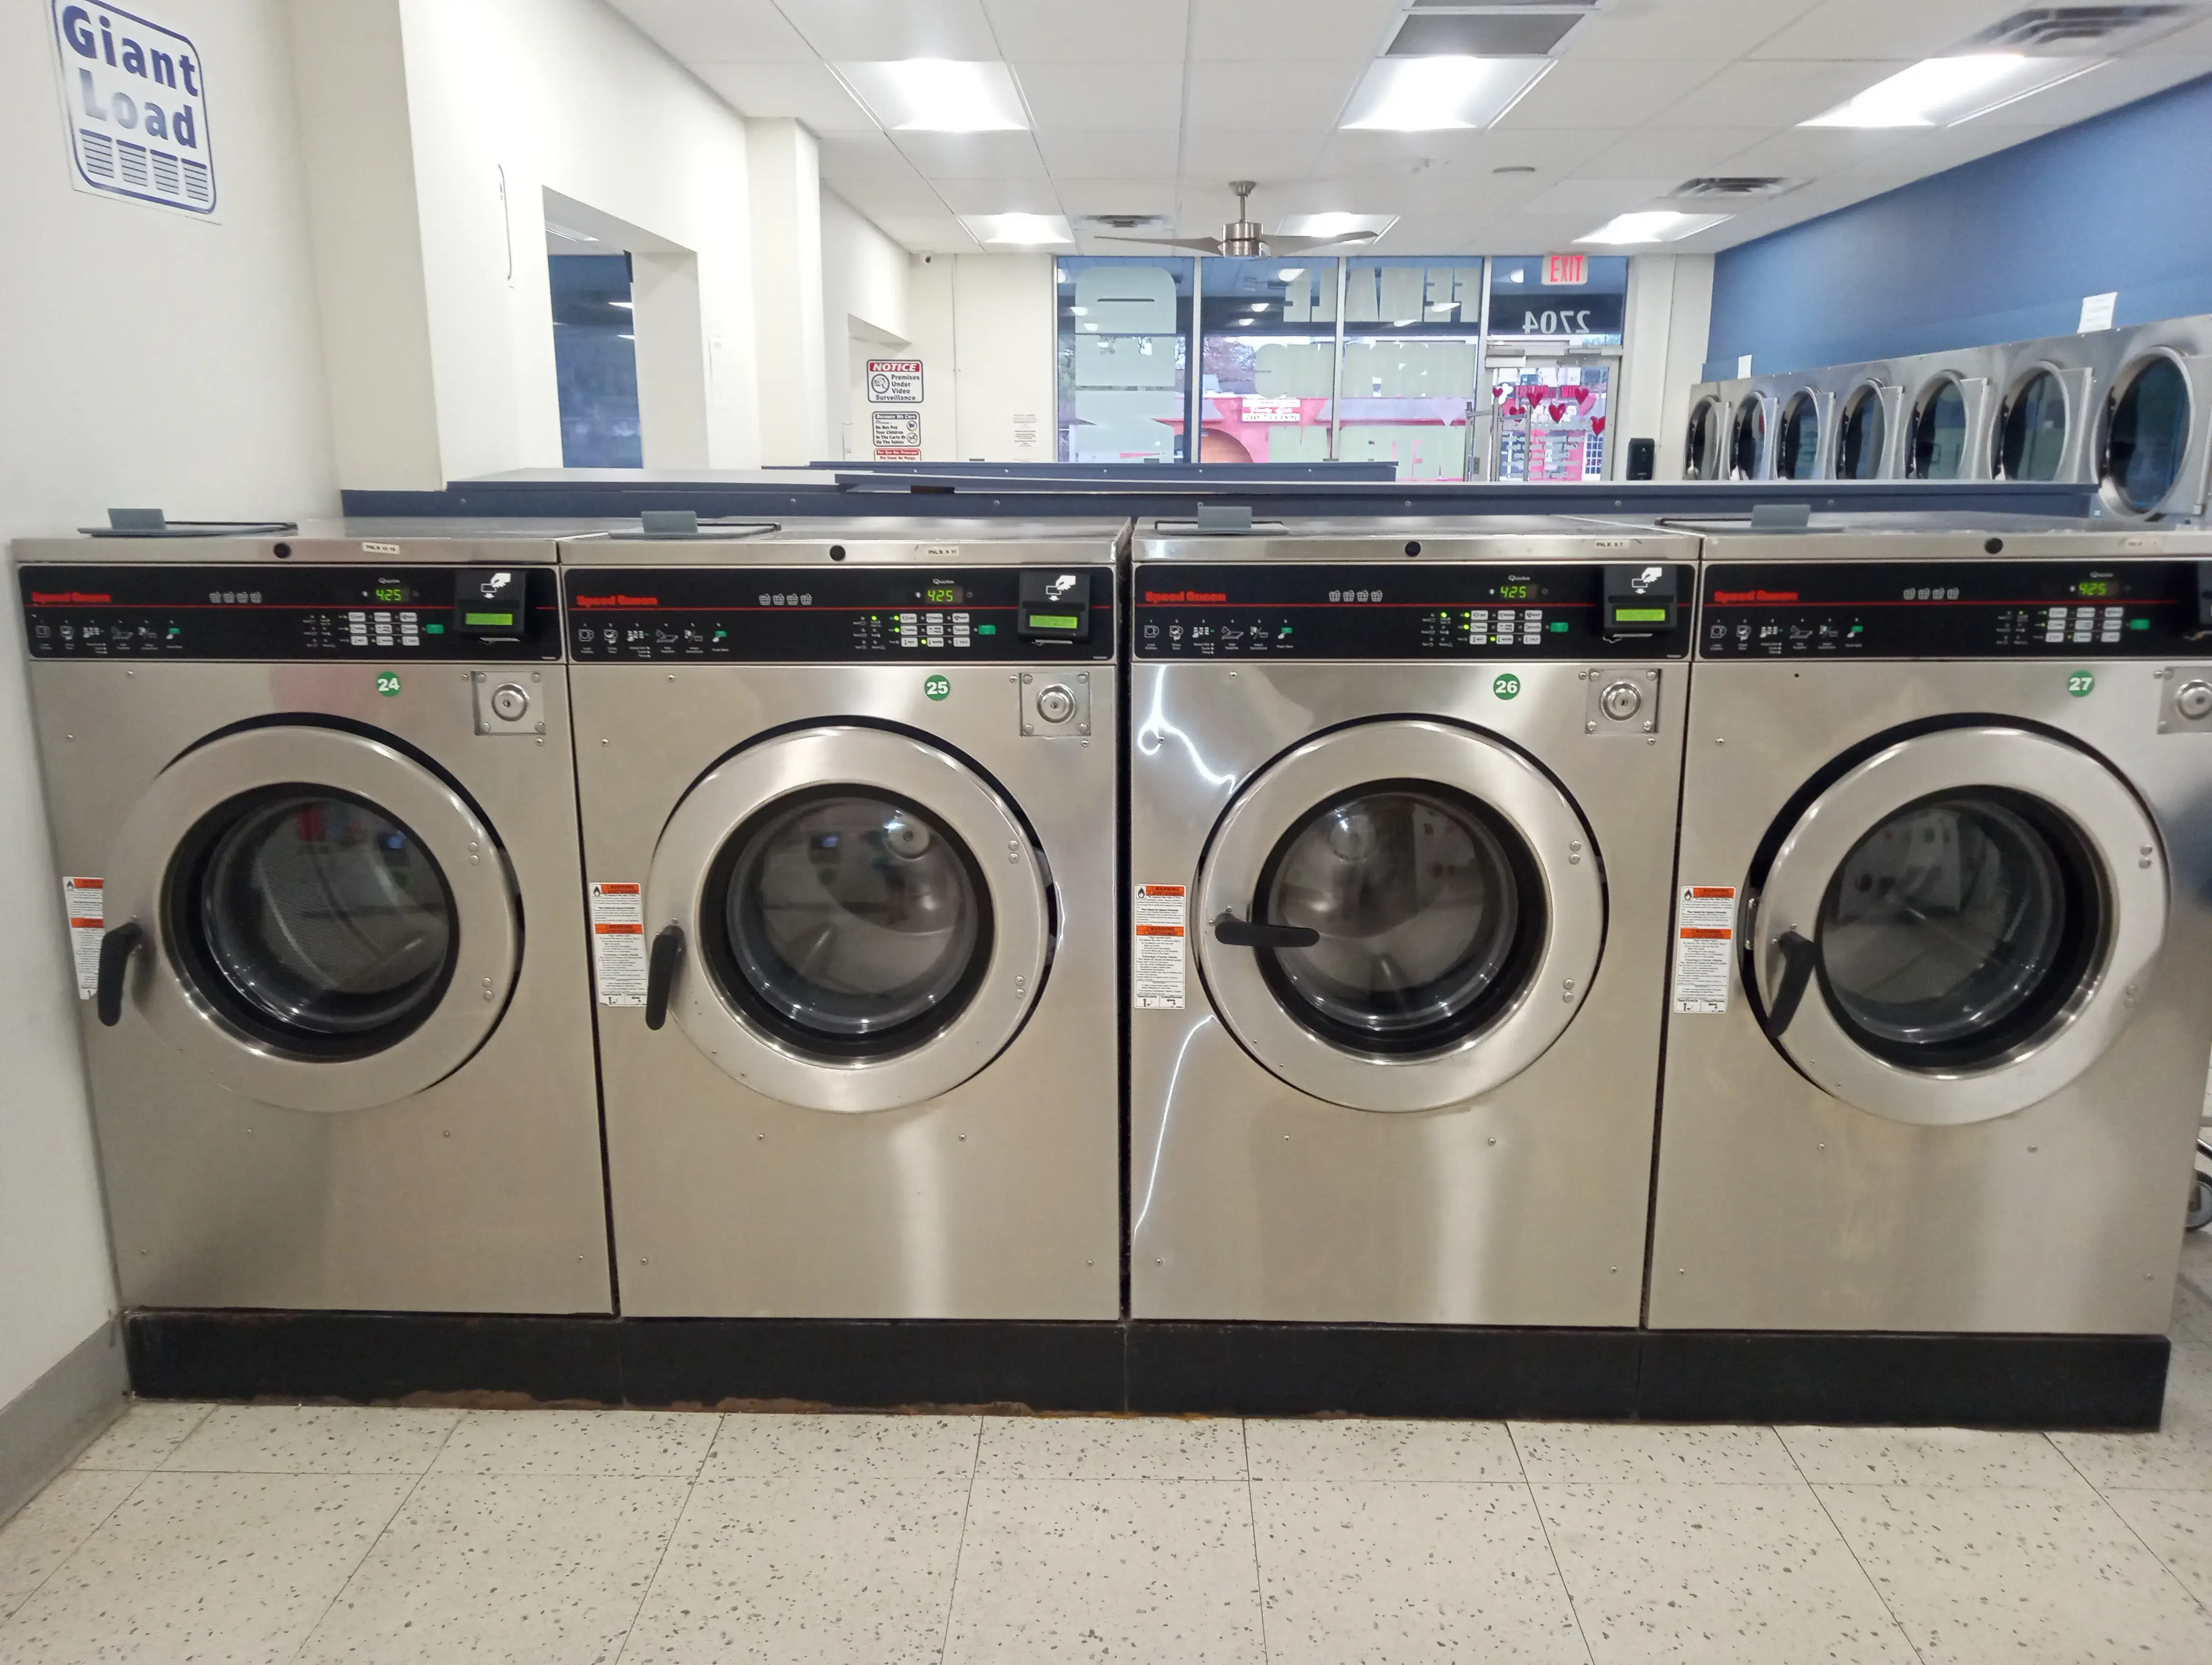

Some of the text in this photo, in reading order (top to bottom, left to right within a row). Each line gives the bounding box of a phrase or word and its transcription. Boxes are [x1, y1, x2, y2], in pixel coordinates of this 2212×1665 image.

[62, 5, 198, 96] Giant
[78, 67, 197, 149] Load
[1550, 255, 1584, 282] EXIT
[873, 363, 917, 371] NOTICE
[376, 588, 401, 601] 425
[1500, 585, 1526, 598] 425
[2079, 582, 2107, 595] 425
[927, 590, 953, 602] 425
[1145, 591, 1226, 603] Speed Queen
[377, 678, 400, 691] 24
[926, 681, 948, 695] 25
[1495, 680, 1517, 694] 26
[2069, 677, 2092, 691] 27
